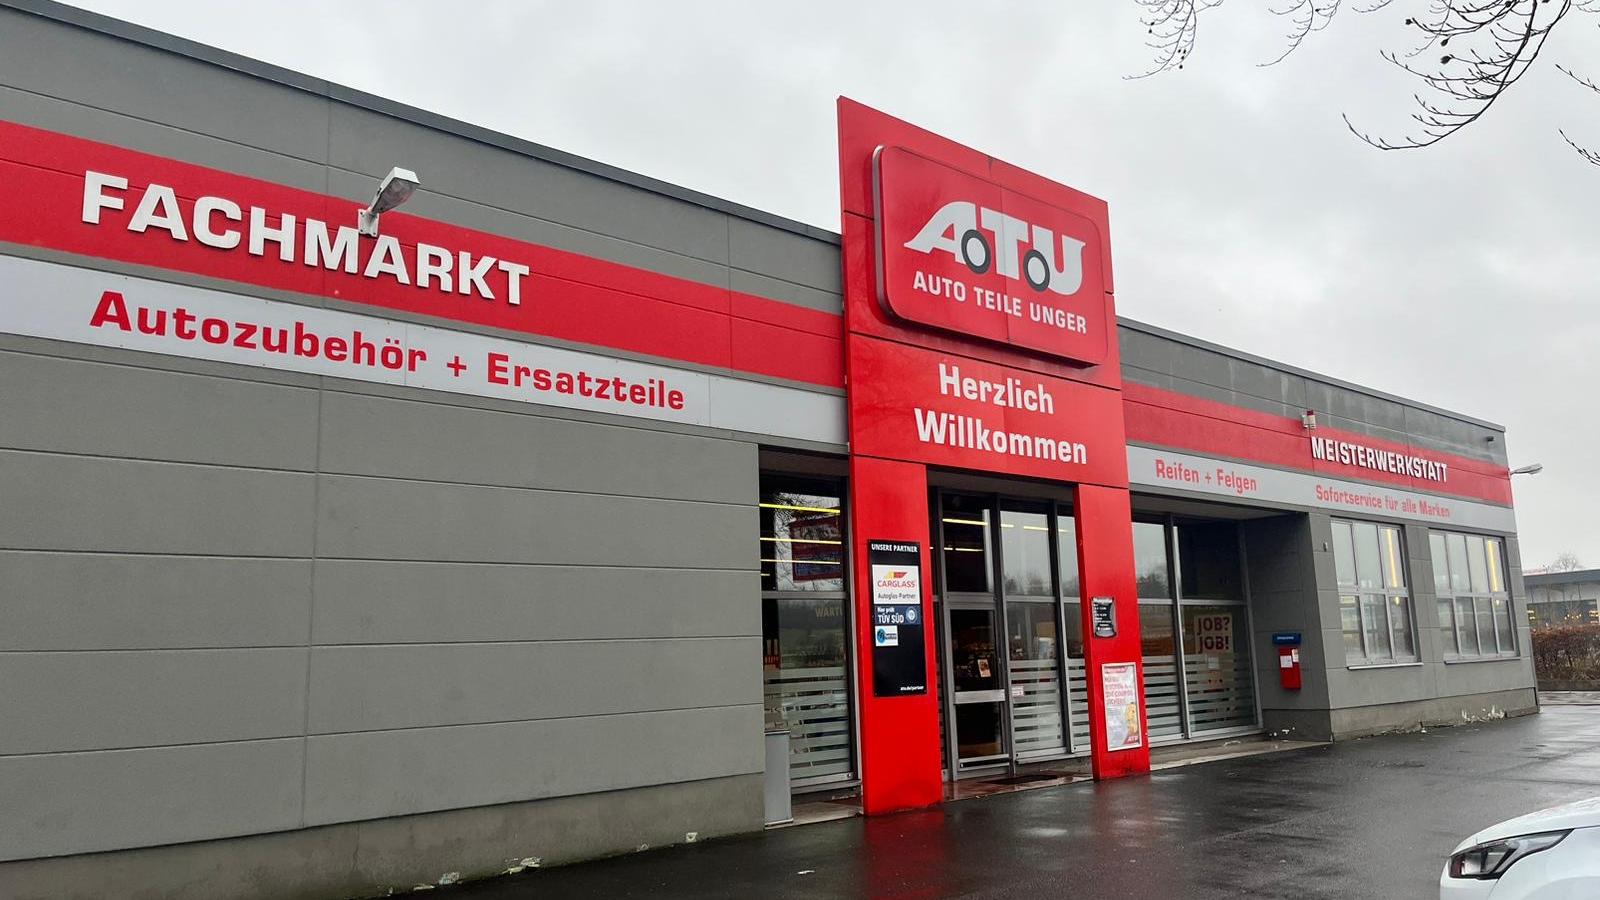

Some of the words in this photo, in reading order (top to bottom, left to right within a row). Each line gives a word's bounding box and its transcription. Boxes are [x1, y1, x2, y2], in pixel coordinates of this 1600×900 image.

[82, 170, 530, 305] FACHMARKT
[904, 201, 1086, 295] ATU
[913, 271, 966, 302] AUTO
[973, 286, 1022, 317] TEILE
[1029, 302, 1087, 334] UNGER
[89, 290, 427, 372] Autozubehör
[447, 355, 467, 377] +
[487, 352, 684, 410] Ersatzteile
[938, 363, 1054, 414] Herzlich
[914, 408, 1087, 465] Willkommen
[1155, 459, 1199, 483] Reifen
[1204, 471, 1212, 484] +
[1216, 468, 1257, 494] Felgen
[1311, 436, 1448, 482] MEISTERWERKSTATT
[1315, 484, 1382, 508] Sofortservice
[1385, 494, 1399, 511] für
[1402, 499, 1417, 514] alle
[1419, 501, 1450, 518] Marken
[871, 543, 892, 552] UNSERE
[893, 544, 918, 553] PARTNER
[877, 580, 916, 588] CARGLASS
[877, 613, 890, 624] TÜV
[891, 612, 905, 624] SÜD
[1197, 616, 1230, 635] JOB?
[1198, 635, 1229, 654] JOB!
